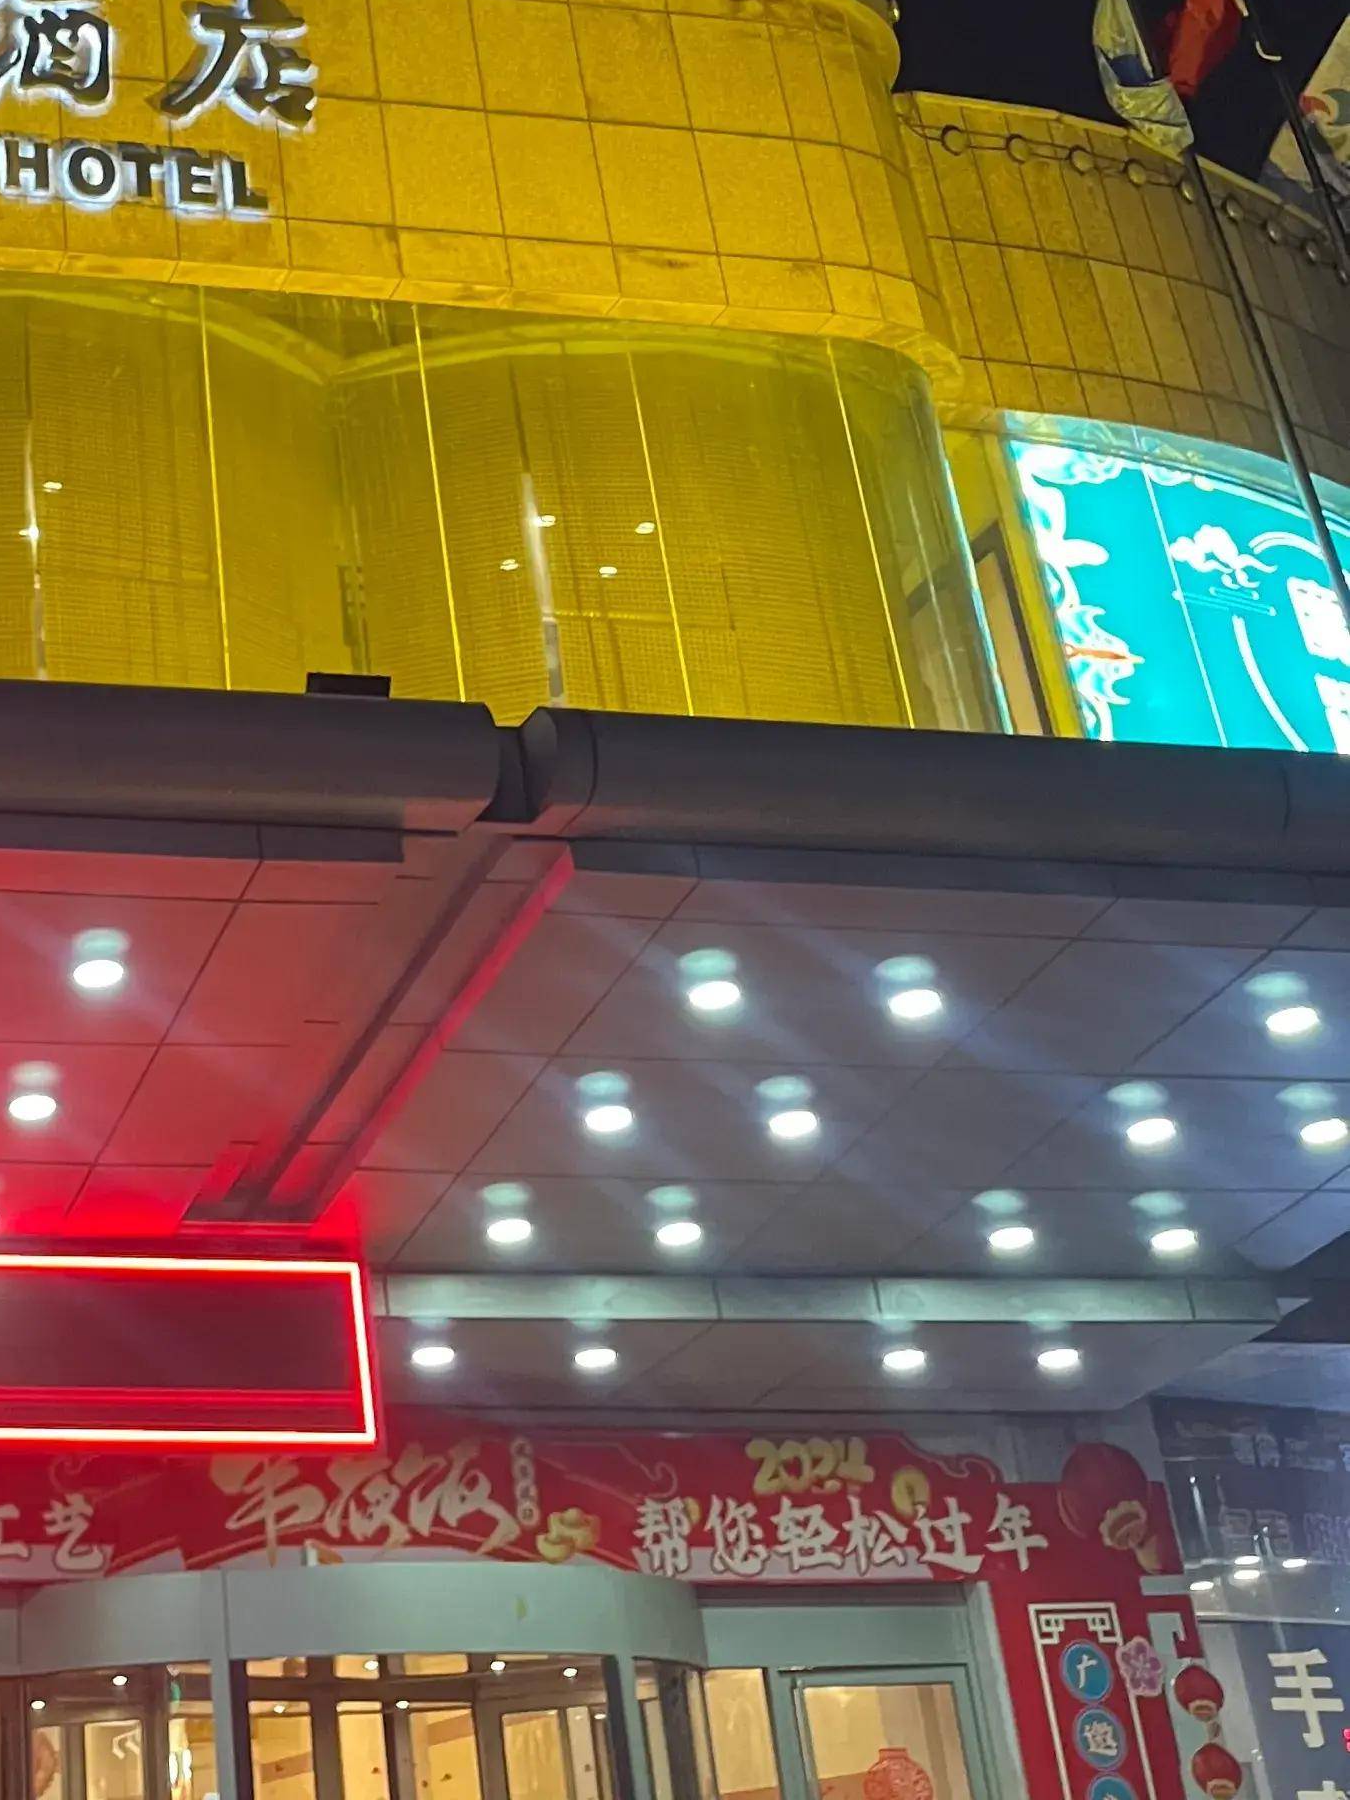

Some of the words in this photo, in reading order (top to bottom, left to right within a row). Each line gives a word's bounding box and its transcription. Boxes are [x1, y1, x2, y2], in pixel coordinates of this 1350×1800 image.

[745, 1437, 876, 1495] 2024
[633, 1494, 1049, 1577] 帮您轻松过年
